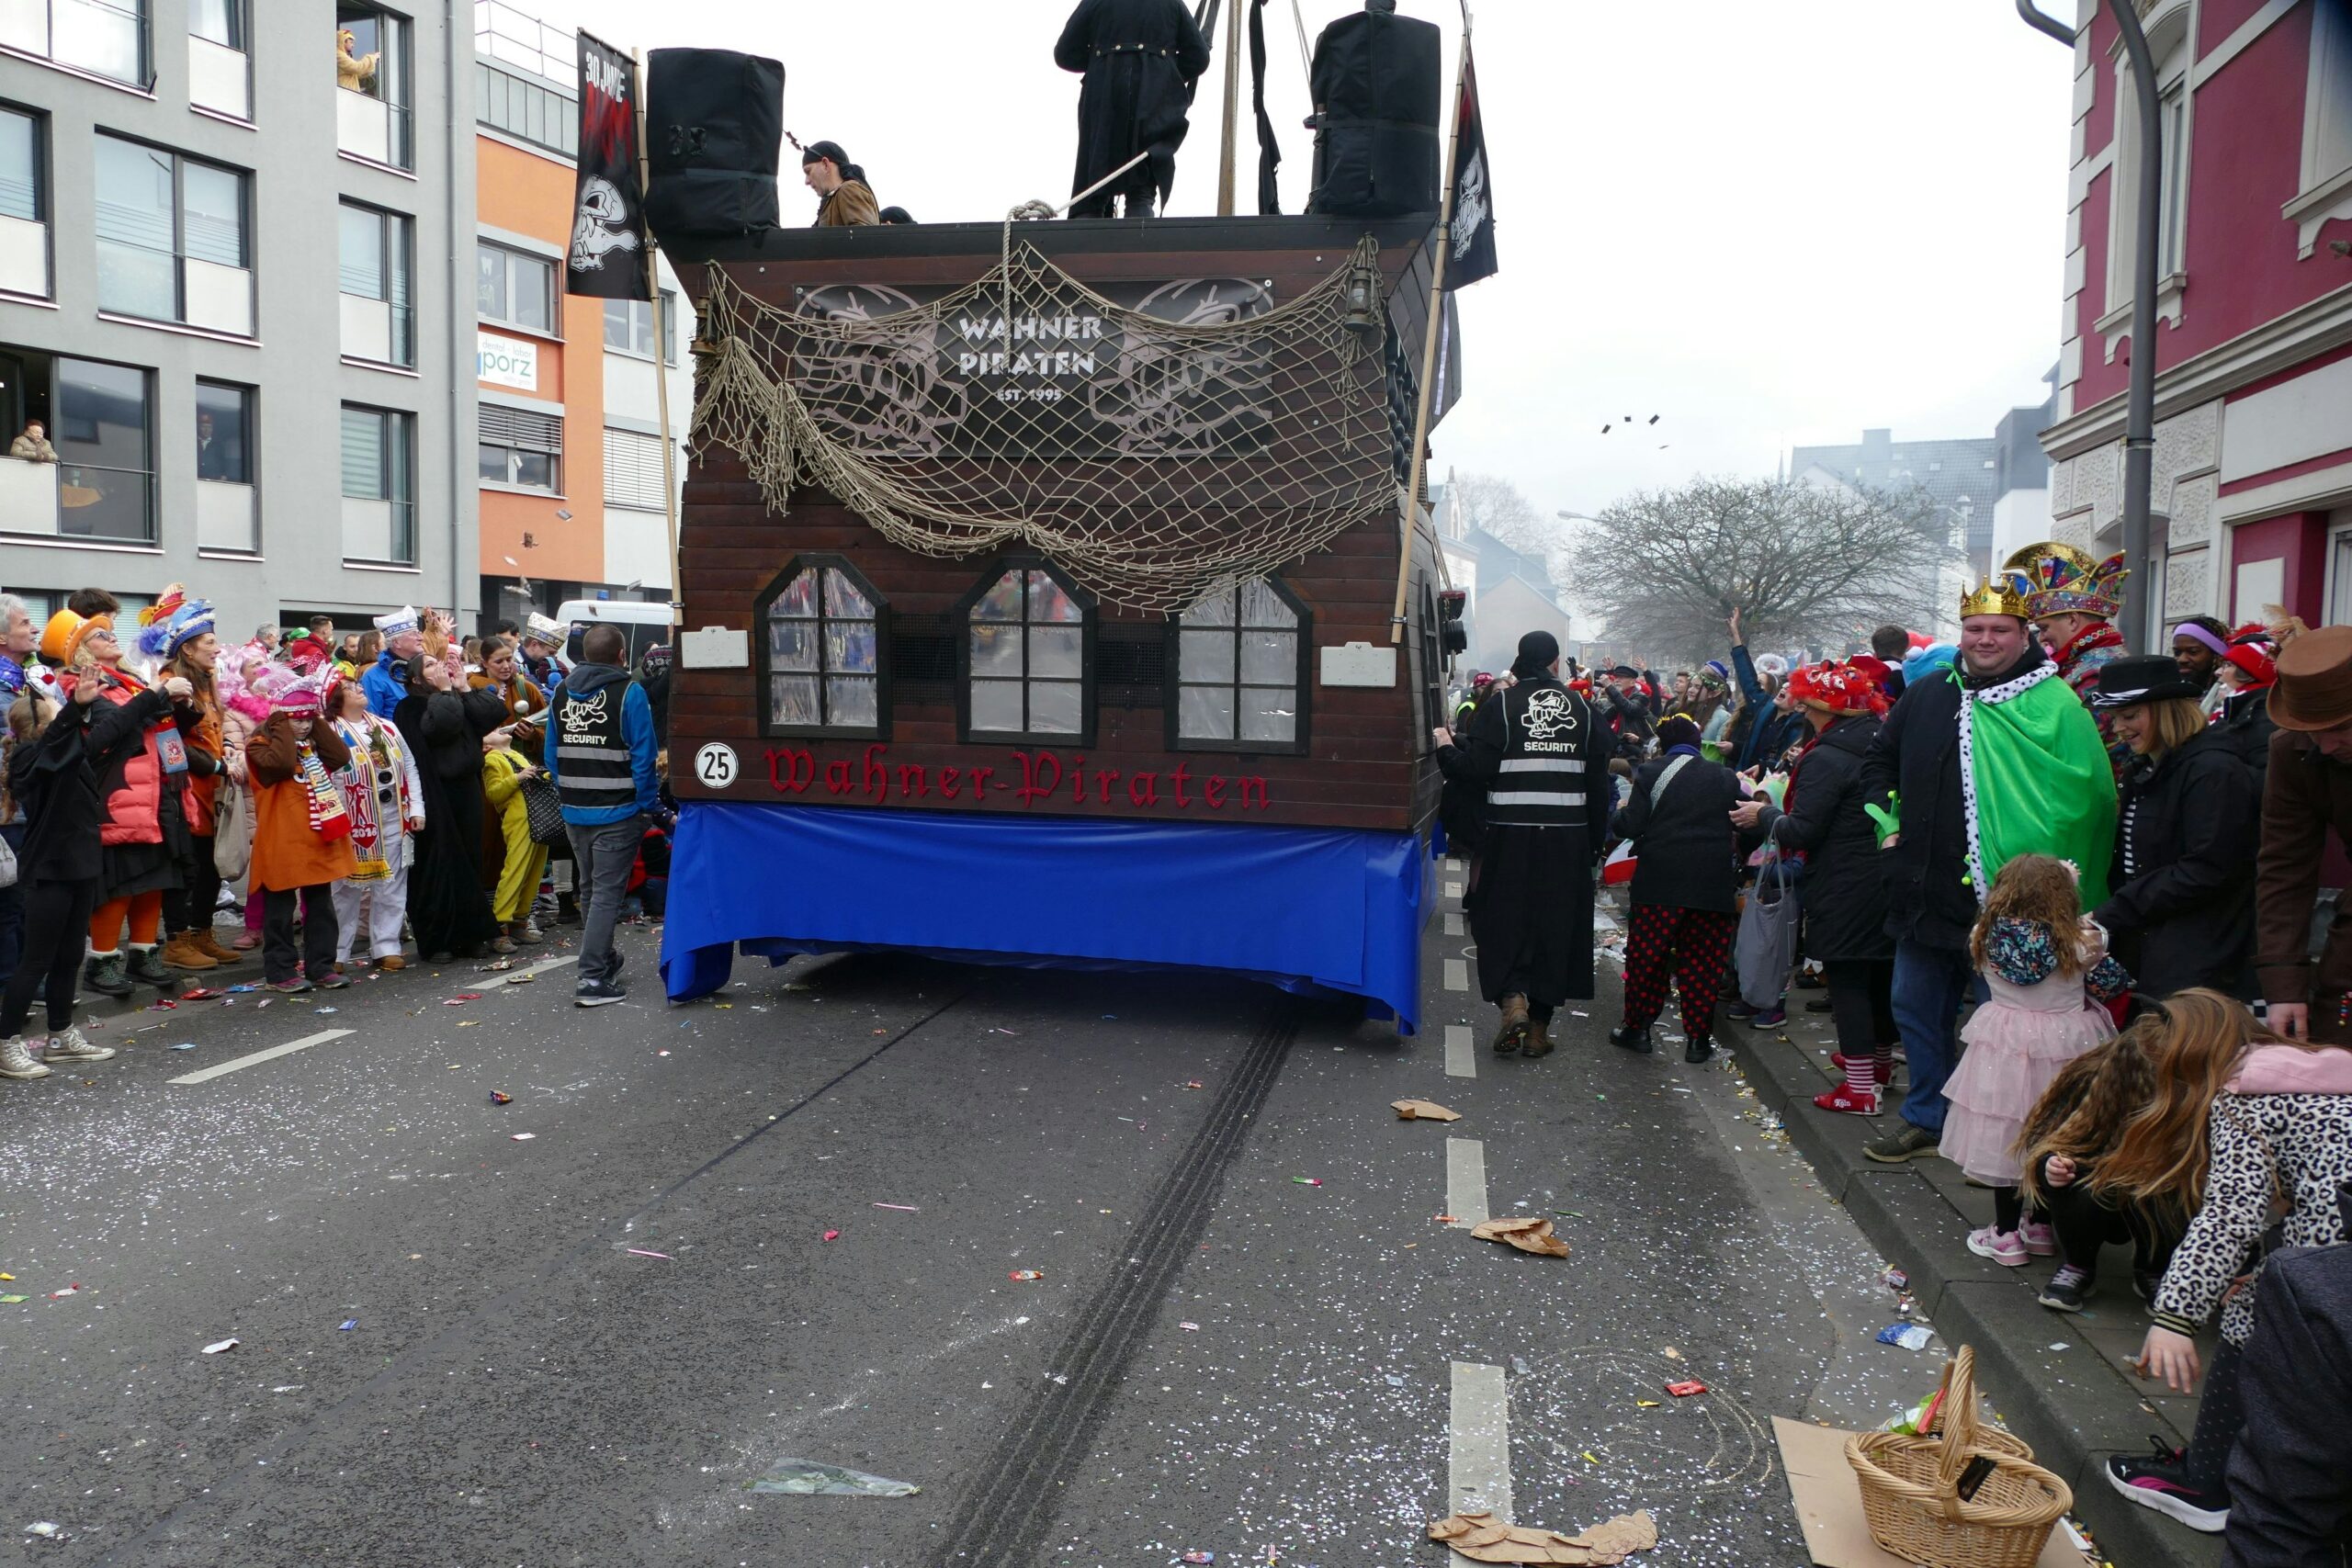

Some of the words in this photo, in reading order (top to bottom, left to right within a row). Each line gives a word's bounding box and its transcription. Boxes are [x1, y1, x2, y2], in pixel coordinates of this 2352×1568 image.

[585, 51, 600, 88] 30
[959, 316, 1102, 341] WAHNER
[482, 337, 504, 353] dental
[513, 344, 531, 359] labor
[483, 352, 531, 377] porz
[959, 351, 1095, 376] PIRATEN
[997, 389, 1025, 401] EST.
[1030, 389, 1062, 401] 1995
[562, 733, 607, 745] SECURITY
[1523, 741, 1577, 752] SECURITY
[703, 750, 729, 781] 25
